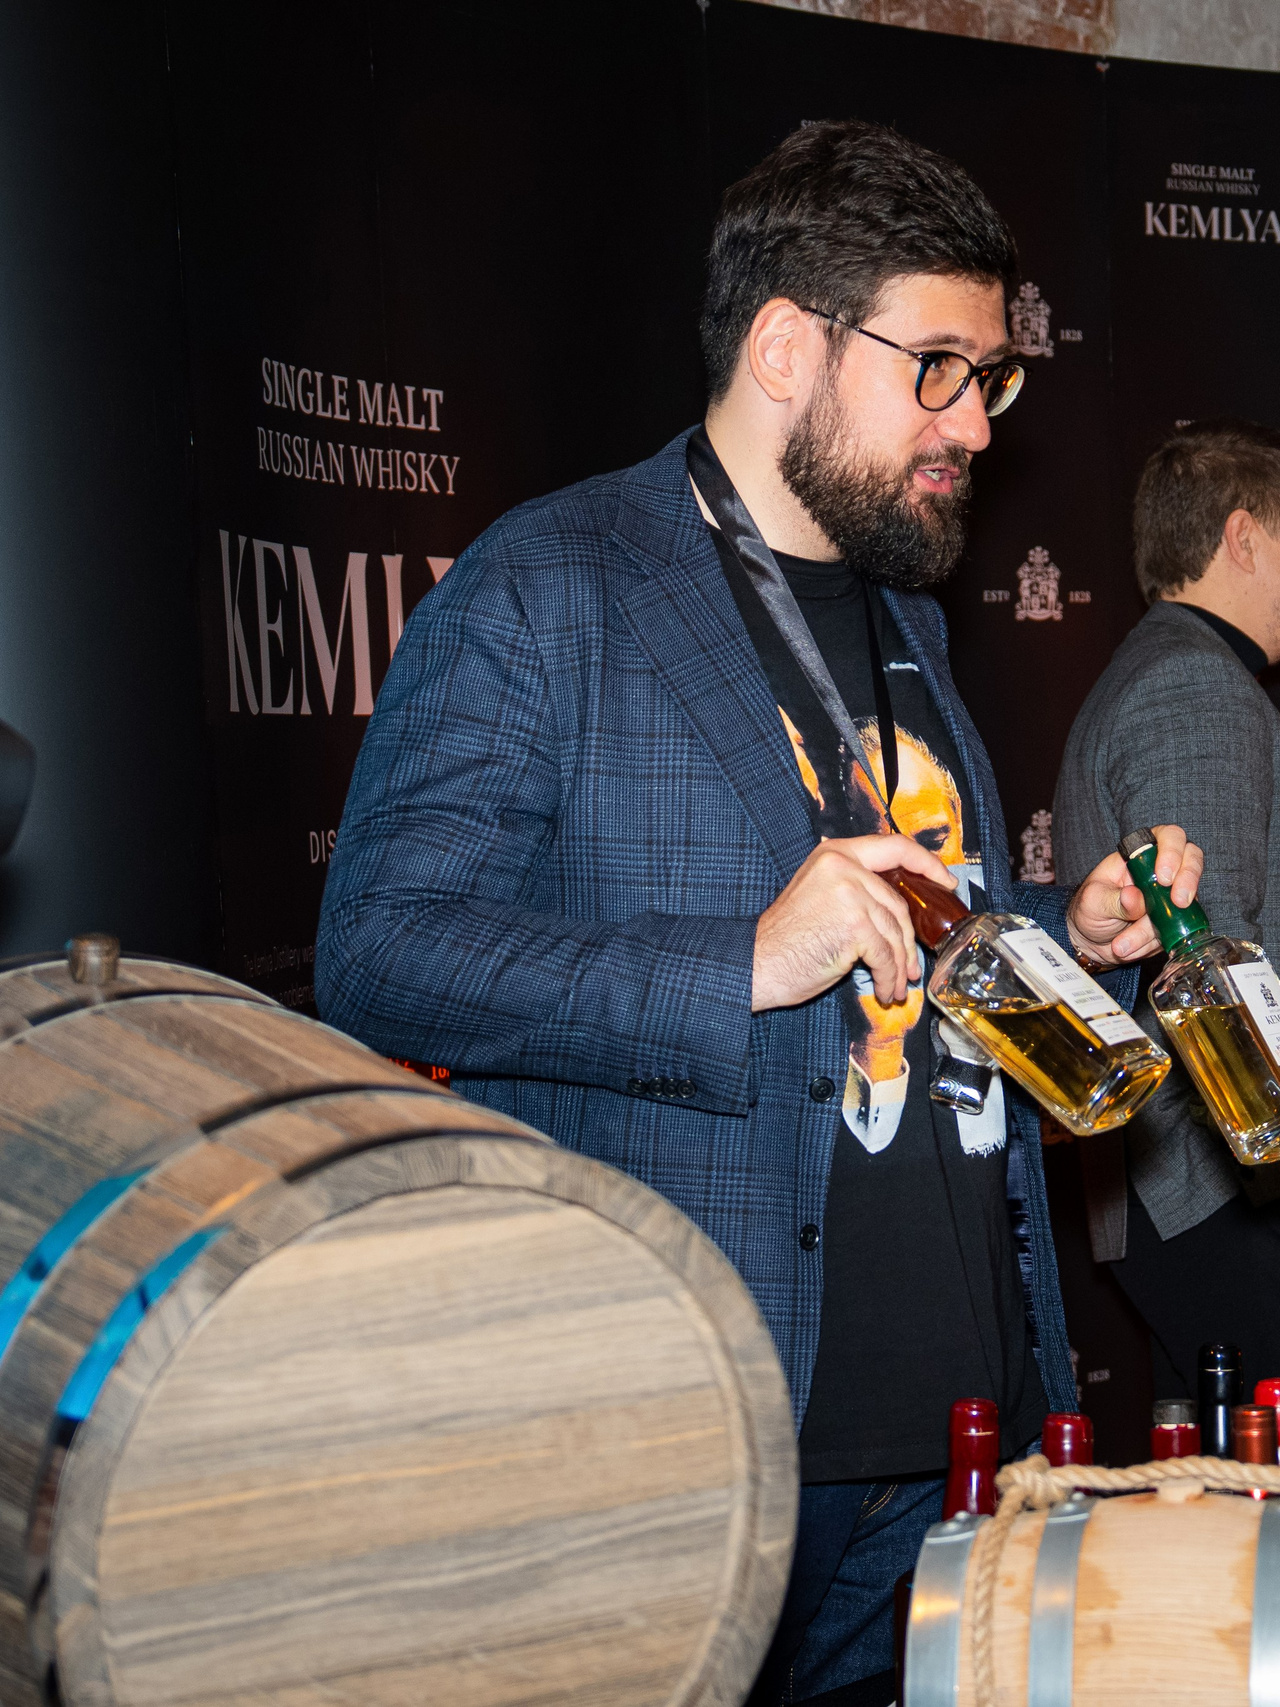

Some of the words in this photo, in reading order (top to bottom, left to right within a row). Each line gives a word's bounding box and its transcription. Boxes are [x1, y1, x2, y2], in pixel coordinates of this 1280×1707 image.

[1166, 177, 1214, 192] RUSSIAN
[1215, 181, 1261, 196] WHISKY
[1171, 162, 1217, 179] SINGLE
[1219, 166, 1255, 181] MALT
[261, 356, 350, 421] SINGLE
[357, 379, 444, 432] MALT
[257, 426, 345, 485] RUSSIAN
[350, 445, 461, 495] WHISKY
